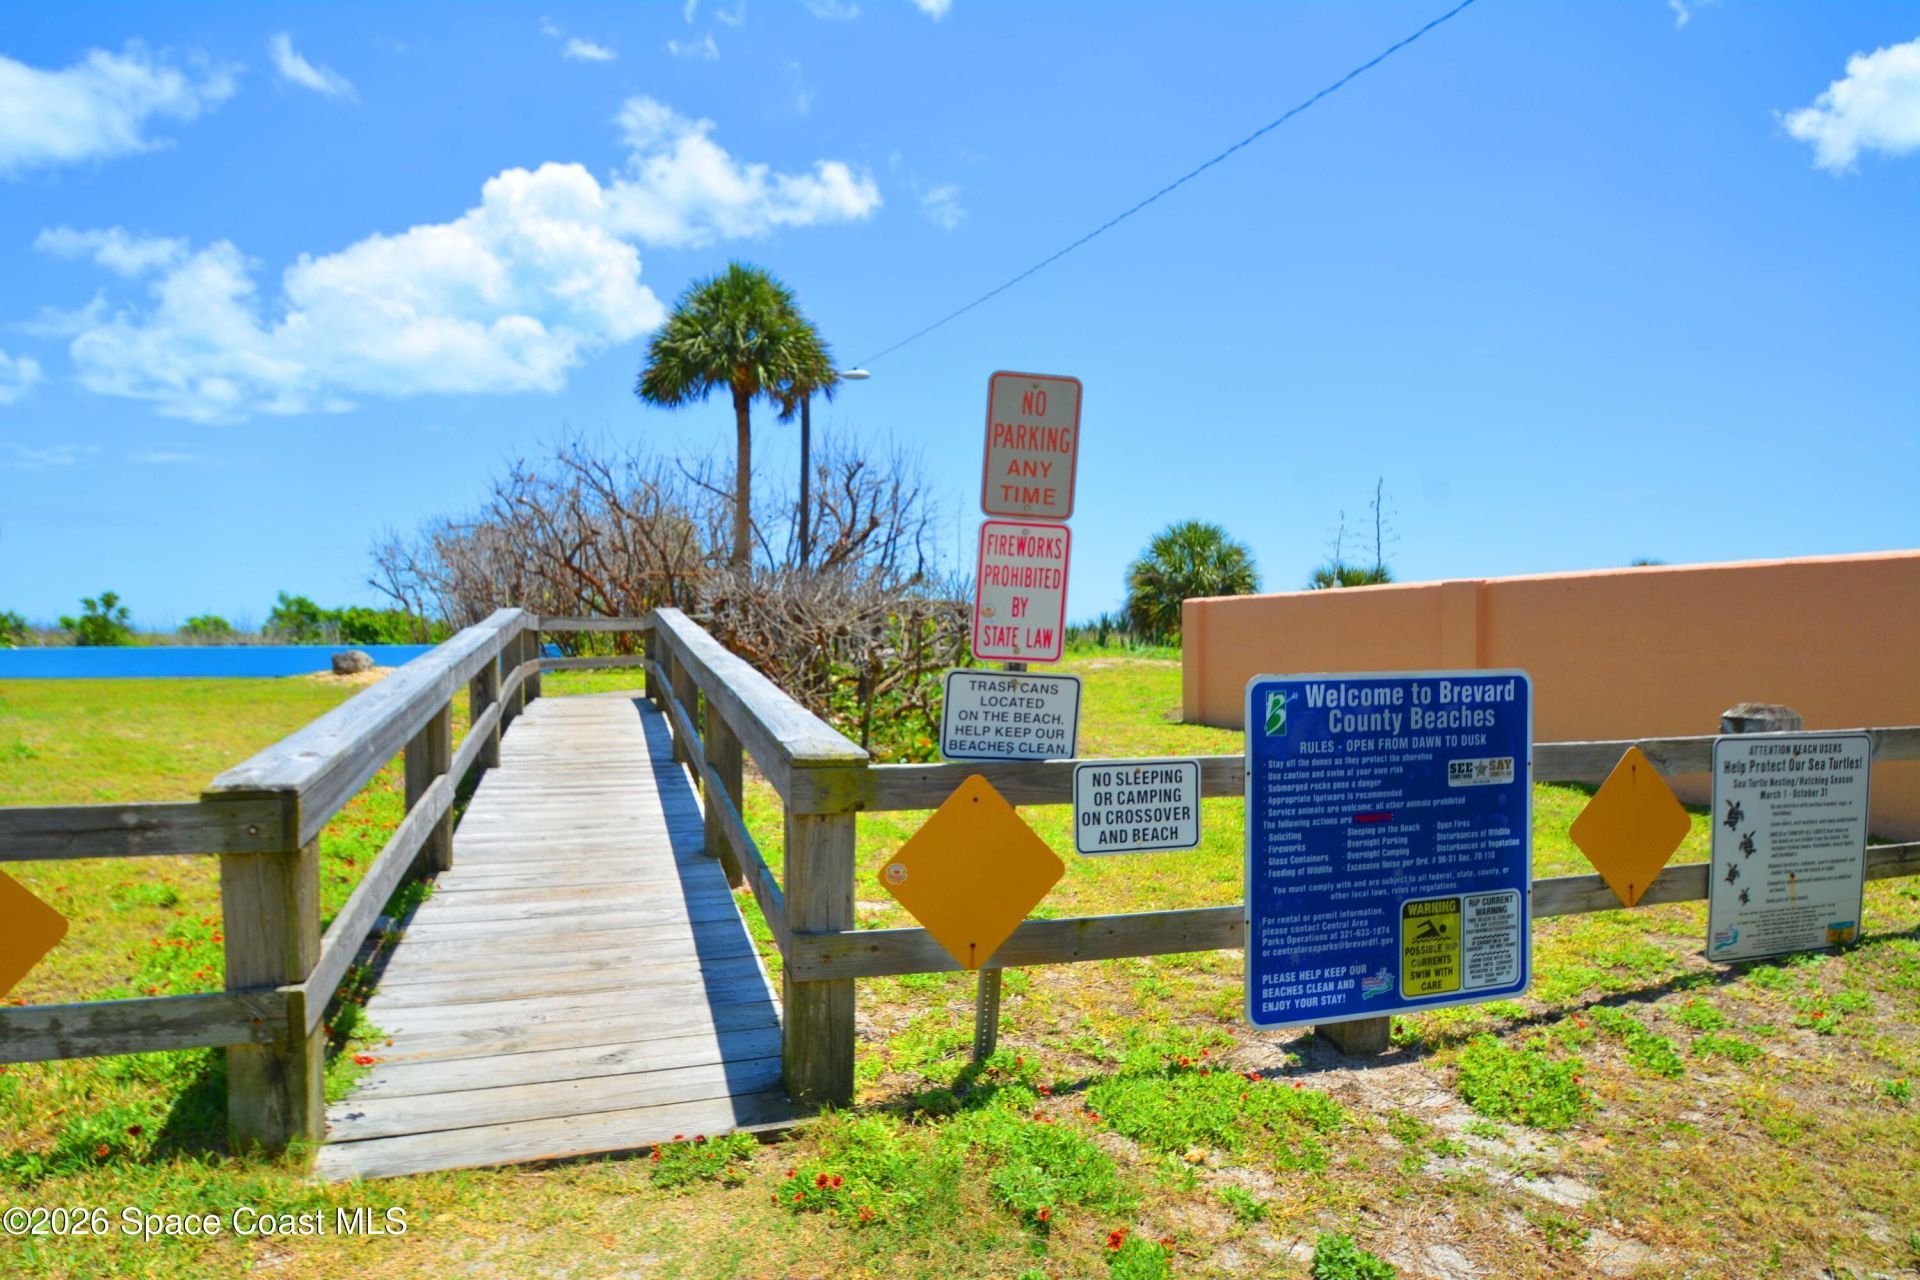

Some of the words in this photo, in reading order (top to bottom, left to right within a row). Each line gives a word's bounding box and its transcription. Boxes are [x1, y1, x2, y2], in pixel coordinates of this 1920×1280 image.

[1022, 390, 1046, 416] NO
[994, 423, 1070, 453] PARKING
[1007, 459, 1052, 478] ANY
[1001, 484, 1056, 506] TIME
[987, 534, 1062, 560] FIREWORKS
[984, 565, 1060, 589] PROHIBITED
[1012, 597, 1028, 618] BY
[983, 626, 1020, 648] STATE
[1026, 628, 1052, 649] LAW
[970, 680, 1016, 692] TRASH
[1021, 683, 1058, 695] CANS
[1305, 683, 1403, 709] Welcome
[1412, 682, 1431, 705] to
[1440, 679, 1515, 703] Brevard
[980, 696, 1044, 709] LOCATED
[958, 710, 978, 720] ON
[982, 711, 1008, 722] THE
[1014, 713, 1064, 725] BEACH.
[1329, 708, 1402, 735] County
[1410, 705, 1495, 730] Beaches
[955, 725, 990, 736] HELP
[995, 726, 1031, 738] KEEP
[1036, 728, 1064, 739] OUR
[949, 740, 1014, 752] BEACHES
[1019, 742, 1068, 755] CLEAN.
[1300, 741, 1334, 754] RULES
[1347, 739, 1375, 751] OPEN
[1378, 737, 1408, 750] FROM
[1412, 737, 1441, 748] DAWN
[1446, 736, 1458, 747] TO
[1461, 734, 1487, 746] DUSK
[1749, 745, 1790, 756] ATTENTION
[1793, 744, 1817, 755] BEACH
[1820, 744, 1842, 753] USERS
[1268, 760, 1283, 769] Stay
[1286, 759, 1296, 767] off
[1298, 758, 1309, 766] the
[1345, 757, 1359, 765] they
[1450, 762, 1473, 773] SEE
[1489, 759, 1512, 771] SAY
[1724, 760, 1746, 775] Help
[1750, 759, 1786, 773] Protect
[1789, 759, 1805, 771] Our
[1808, 759, 1825, 770] Sea
[1829, 757, 1862, 770] Turtles!
[1093, 772, 1111, 787] NO
[1116, 769, 1182, 786] SLEEPING
[1268, 772, 1280, 780] Use
[1284, 771, 1309, 779] caution
[1312, 770, 1324, 778] and
[1326, 769, 1344, 777] swim
[1347, 768, 1353, 776] at
[1356, 768, 1371, 777] your
[1268, 782, 1308, 793] Submerged
[1310, 781, 1330, 790] rocks
[1358, 779, 1382, 788] danger
[1733, 779, 1746, 789] Sea
[1749, 779, 1768, 788] Turtle
[1770, 776, 1829, 788] Nesting/Hatching
[1831, 776, 1853, 784] Season
[1094, 792, 1112, 806] OR
[1117, 788, 1181, 805] CAMPING
[1268, 795, 1310, 805] Appropriate
[1760, 790, 1781, 800] March
[1793, 789, 1819, 798] October
[1821, 788, 1827, 796] 31
[1082, 812, 1100, 826] ON
[1106, 806, 1190, 825] CROSSOVER
[1268, 808, 1295, 817] Service
[1298, 806, 1324, 814] animals
[1264, 821, 1275, 829] The
[1278, 819, 1310, 828] following
[1312, 817, 1337, 826] actions
[1437, 821, 1452, 830] Open
[1454, 820, 1470, 828] Fires
[1099, 829, 1127, 844] AND
[1133, 826, 1178, 842] BEACH
[1269, 833, 1301, 841] Soliciting
[1347, 827, 1375, 836] Sleeping
[1388, 825, 1398, 833] the
[1268, 844, 1306, 853] Fireworks
[1347, 838, 1379, 848] Overnight
[1268, 857, 1288, 865] Glass
[1290, 855, 1328, 864] Containers
[1347, 850, 1379, 859] Overnight
[1268, 869, 1295, 878] Feeding
[1307, 865, 1332, 874] Wildlife
[1347, 862, 1379, 871] Excessive
[1402, 859, 1414, 867] per
[1309, 883, 1334, 891] comply
[1331, 892, 1349, 900] other
[1469, 898, 1480, 907] RIP
[1482, 895, 1513, 906] CURRENT
[1408, 900, 1456, 915] WARNING
[1475, 906, 1507, 916] WARNING
[1262, 917, 1275, 925] For
[1278, 914, 1300, 924] rental
[1313, 912, 1337, 921] permit
[1262, 927, 1288, 937] please
[1291, 924, 1319, 933] contact
[1322, 920, 1348, 929] Central
[1262, 938, 1284, 946] Parks
[1287, 934, 1328, 944] Operations
[1262, 949, 1270, 957] or
[1405, 944, 1442, 956] POSSIBLE
[1411, 955, 1451, 967] CURRENTS
[1262, 972, 1296, 985] PLEASE
[1299, 969, 1321, 981] HELP
[1324, 966, 1346, 978] KEEP
[1349, 964, 1367, 975] OUR
[1410, 969, 1431, 980] SWIM
[1435, 967, 1453, 977] WITH
[1262, 985, 1303, 999] BEACHES
[1306, 982, 1334, 993] CLEAN
[1337, 979, 1355, 990] AND
[1421, 981, 1442, 991] CARE
[1262, 1000, 1291, 1012] ENJOY
[1294, 997, 1318, 1009] YOUR
[1321, 994, 1346, 1006] STAY!
